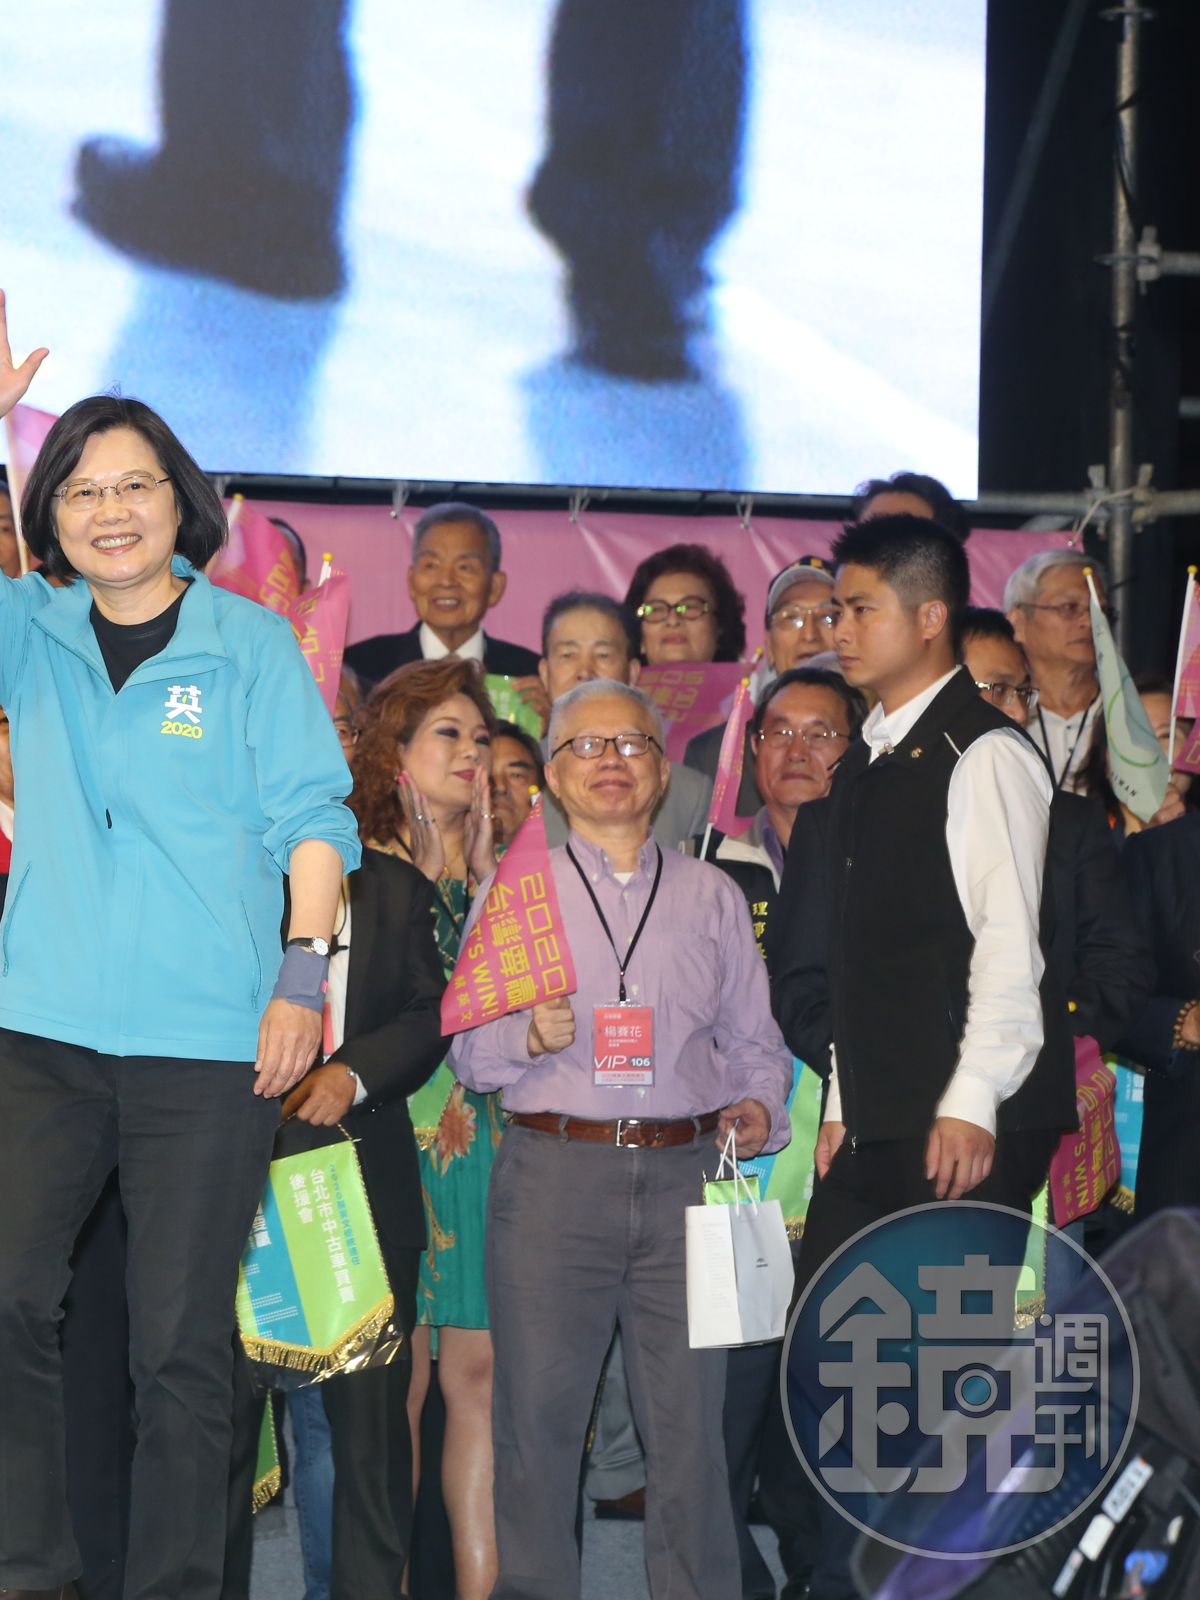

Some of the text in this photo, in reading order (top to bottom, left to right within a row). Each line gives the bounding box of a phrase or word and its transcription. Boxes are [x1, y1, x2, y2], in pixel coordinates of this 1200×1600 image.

[164, 685, 203, 724] 英
[160, 720, 203, 739] 2020
[485, 882, 538, 1009] 台灣要贏
[520, 872, 567, 995] 2020
[472, 961, 499, 1017] WIN!
[594, 1055, 651, 1069] VIP 106
